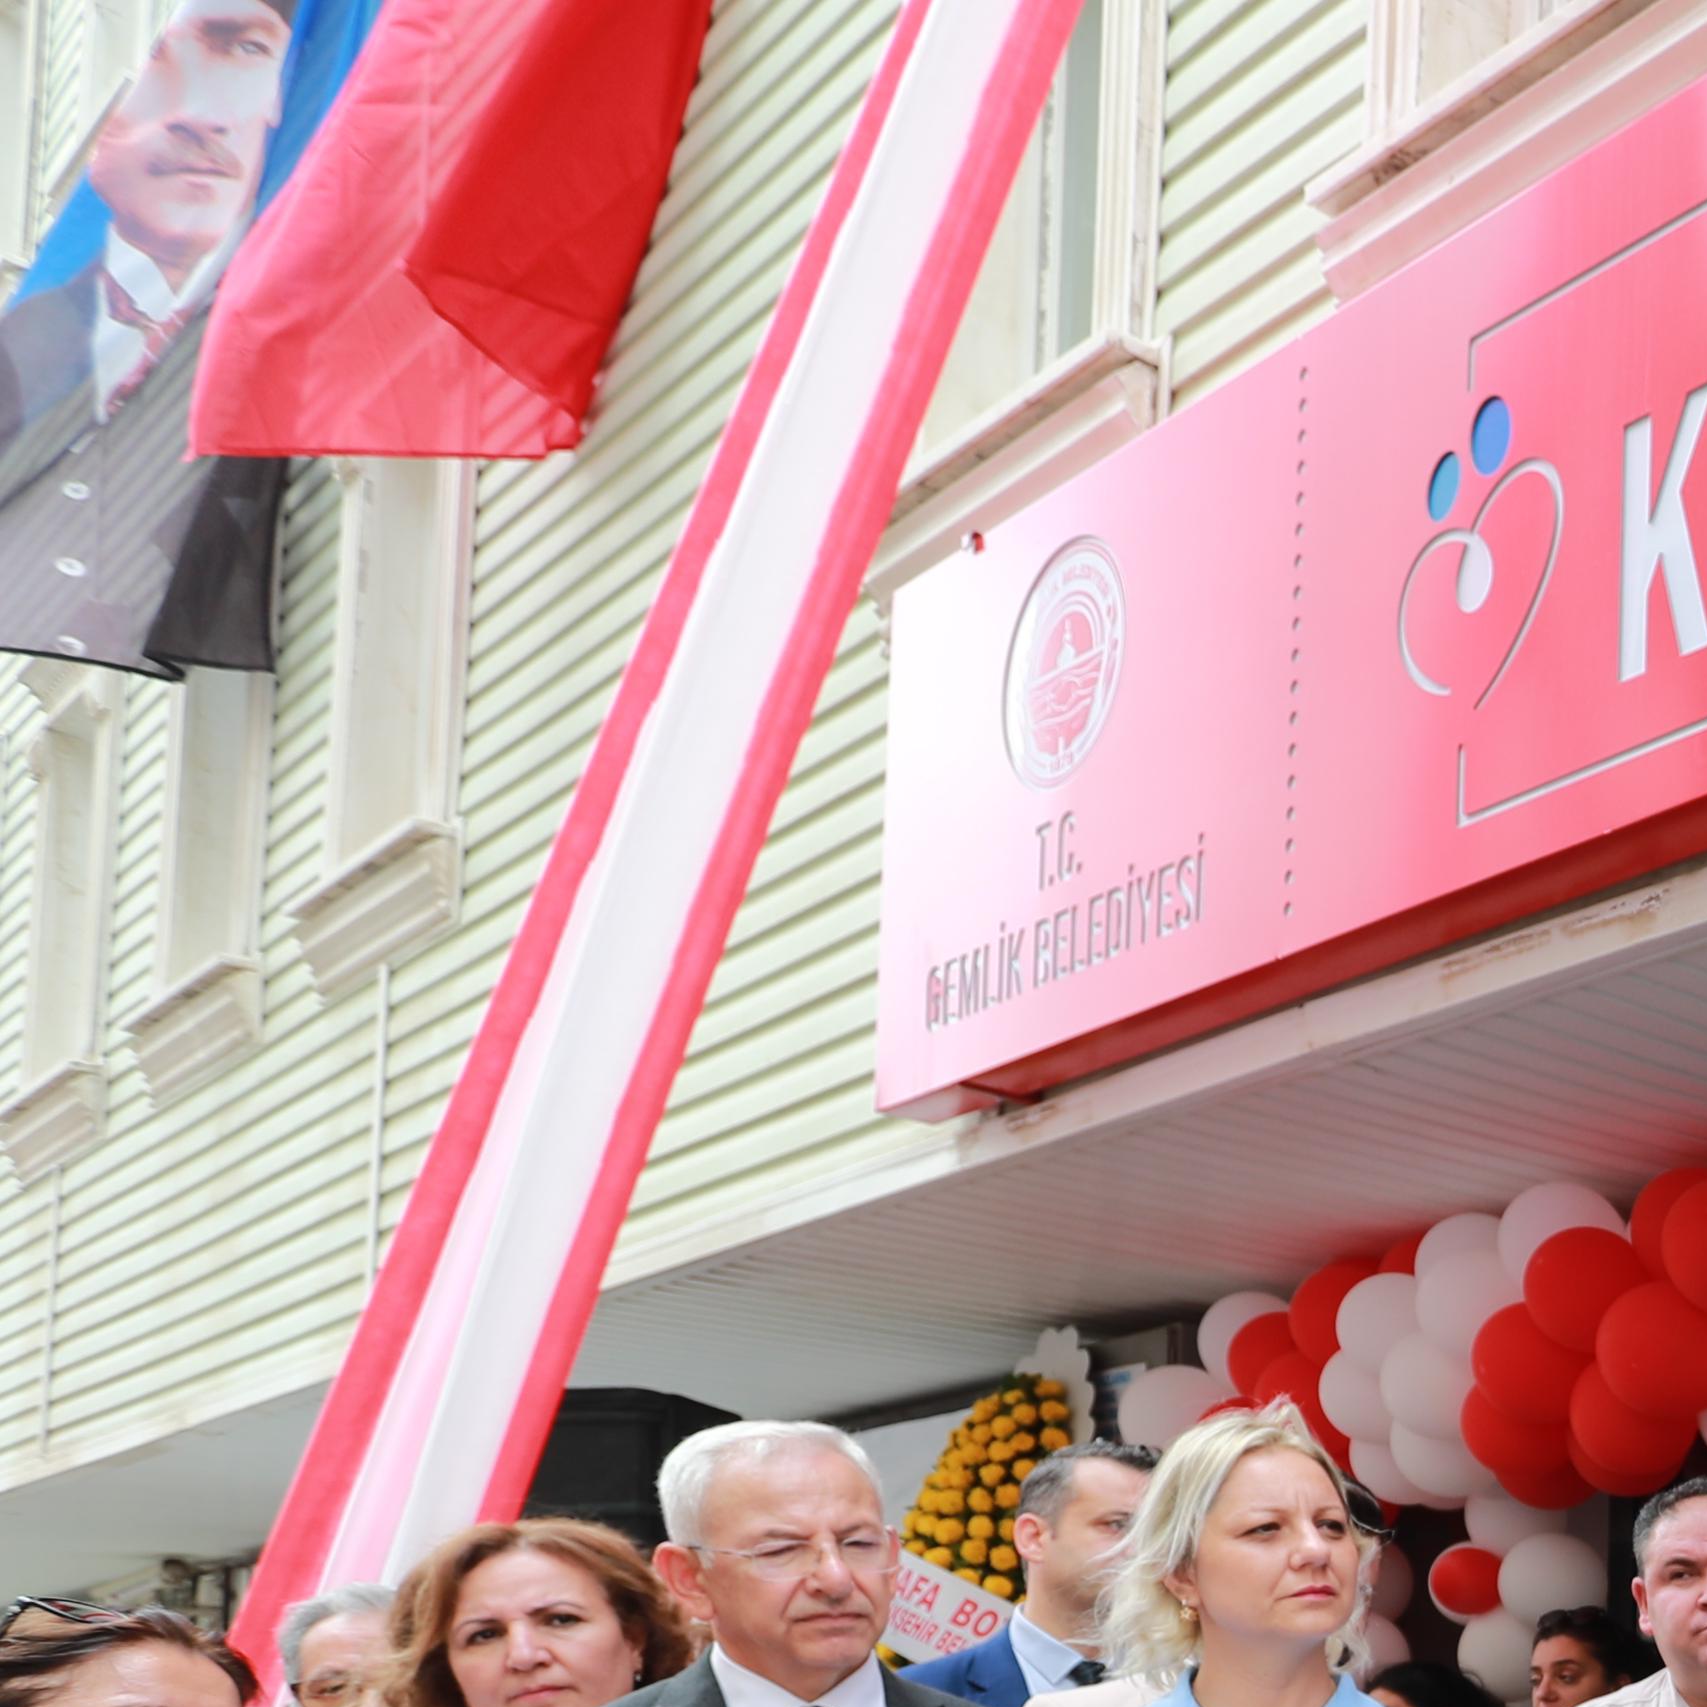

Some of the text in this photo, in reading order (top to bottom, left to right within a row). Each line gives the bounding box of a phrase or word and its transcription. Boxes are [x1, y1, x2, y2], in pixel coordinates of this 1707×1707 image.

[1035, 810, 1083, 891] T.C.
[925, 832, 1204, 1032] GEMLİK BELEDİYESİ
[949, 1597, 999, 1639] BO
